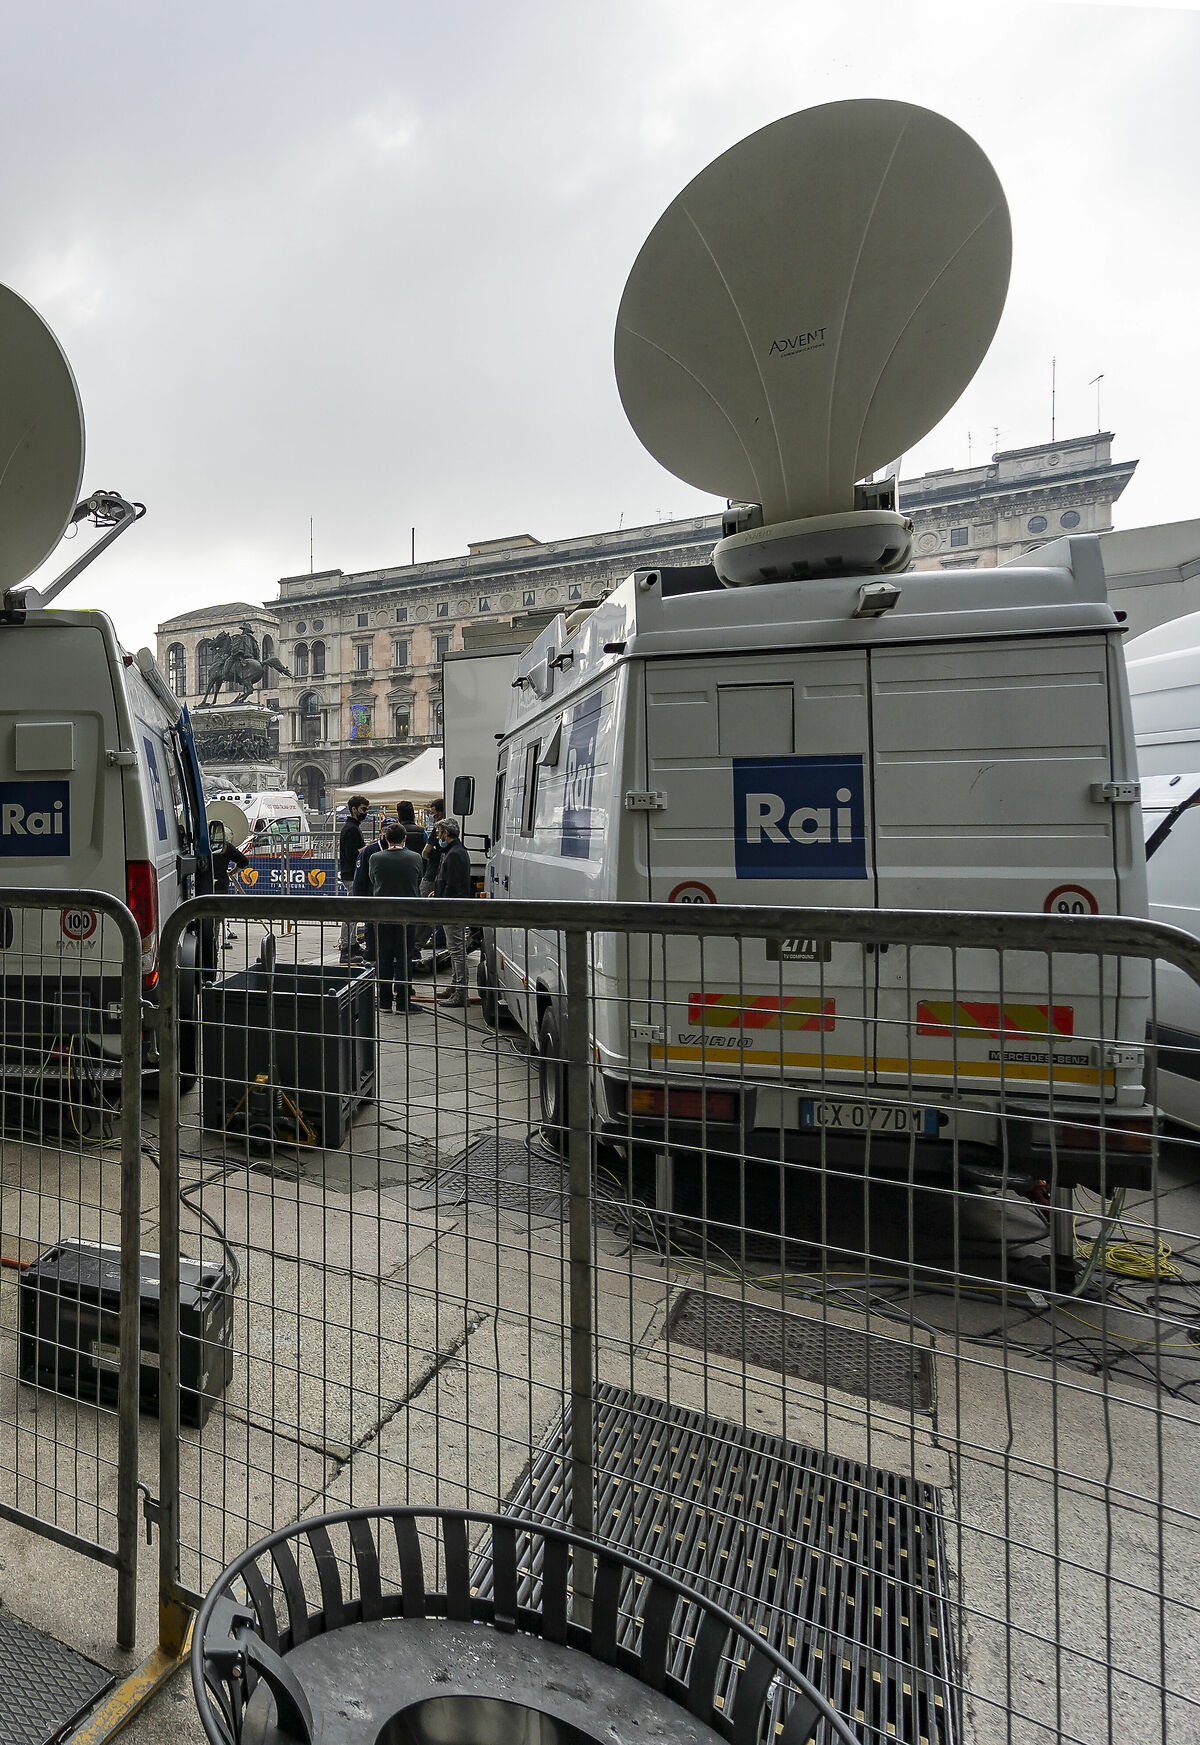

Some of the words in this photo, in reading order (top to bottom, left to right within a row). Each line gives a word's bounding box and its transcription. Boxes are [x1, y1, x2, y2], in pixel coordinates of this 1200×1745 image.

[769, 327, 827, 356] ADVENT
[564, 737, 595, 812] Rai
[2, 800, 63, 835] Rai
[746, 787, 852, 844] Rai
[270, 869, 305, 883] sara
[67, 914, 90, 929] 100
[678, 1033, 754, 1049] VARIO
[991, 1051, 1088, 1065] MERCEDES-BENZ
